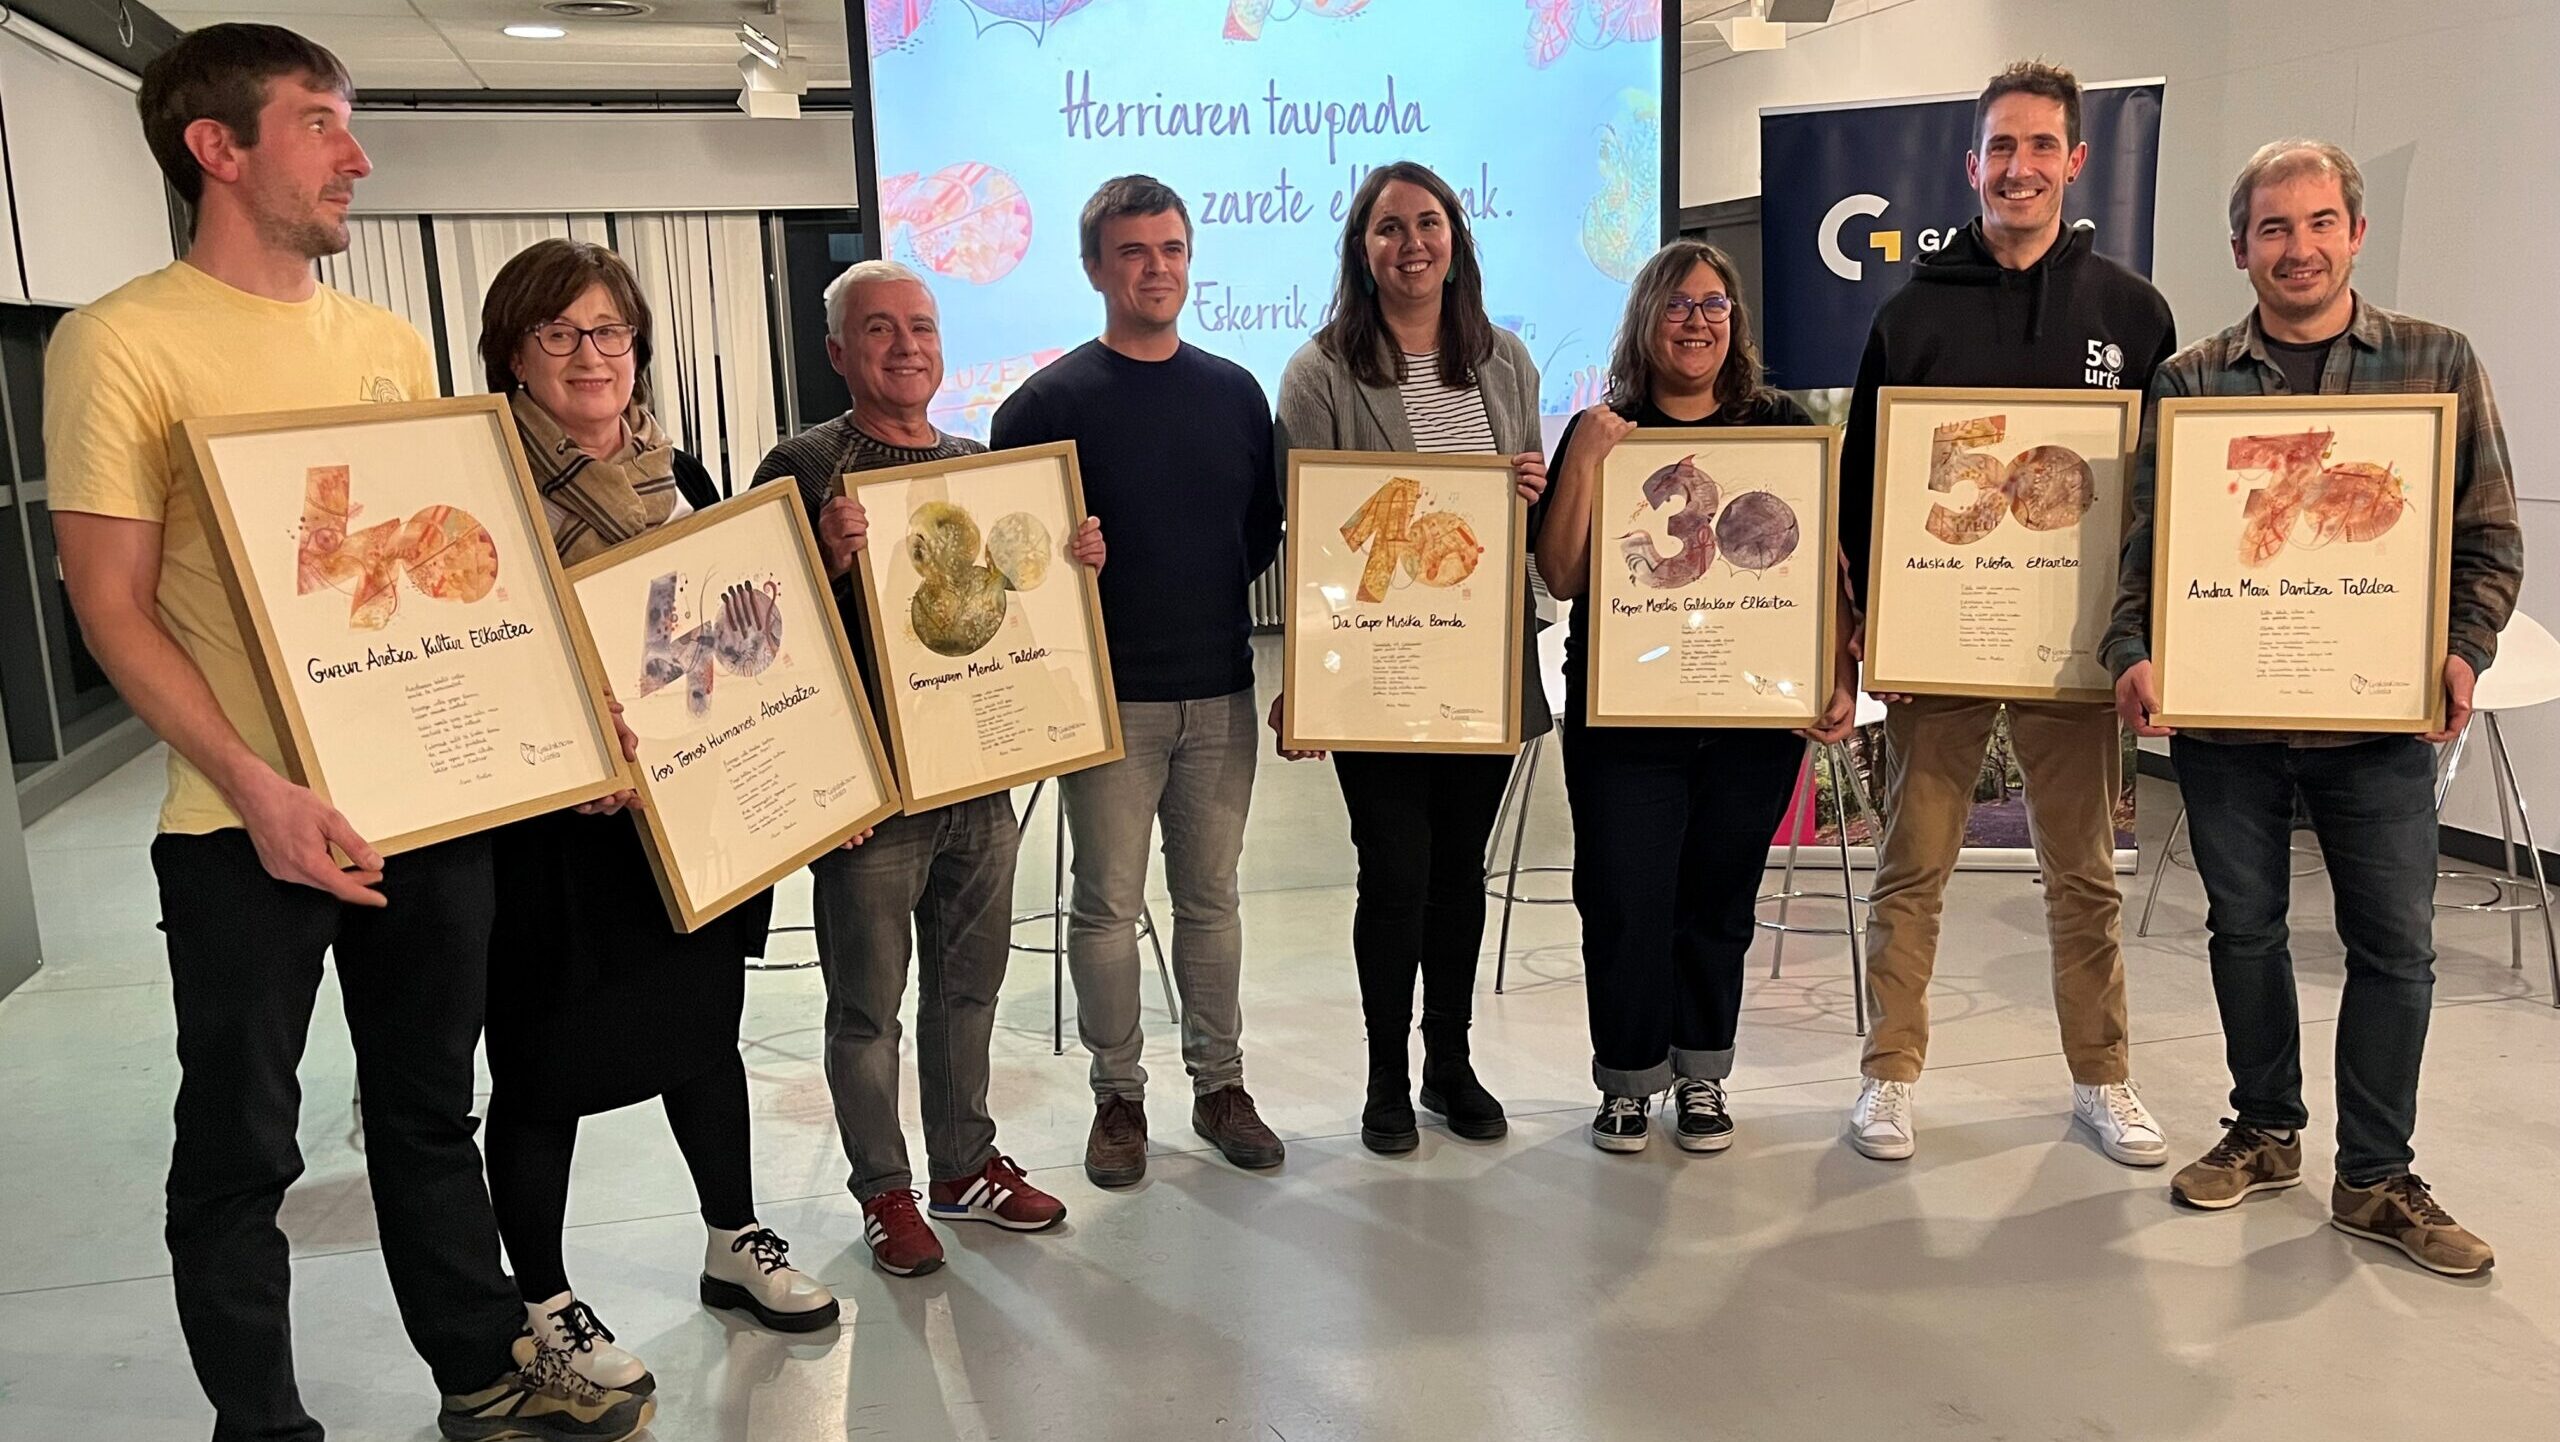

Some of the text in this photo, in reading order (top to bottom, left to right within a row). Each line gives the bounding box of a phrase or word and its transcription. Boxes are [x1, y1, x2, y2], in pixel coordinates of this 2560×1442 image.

[1059, 69, 1431, 165] Herriaren taupada
[1199, 167, 1314, 225] zarete
[1193, 280, 1308, 332] Eskerrik
[941, 357, 1017, 394] LUZE
[2084, 368, 2121, 390] urte
[1906, 556, 1964, 570] Adiskide
[1975, 555, 2015, 570] Pilota
[2187, 577, 2400, 600] Andra Mari Dantza Taldea
[1331, 612, 1467, 632] Da Capo Musika Banda
[366, 643, 418, 671] Aretxa
[420, 635, 465, 659] Kultur
[909, 647, 1052, 691] Ganguren Mendi Taldea
[651, 684, 821, 783] Los Tonos Humanos Abesbatza
